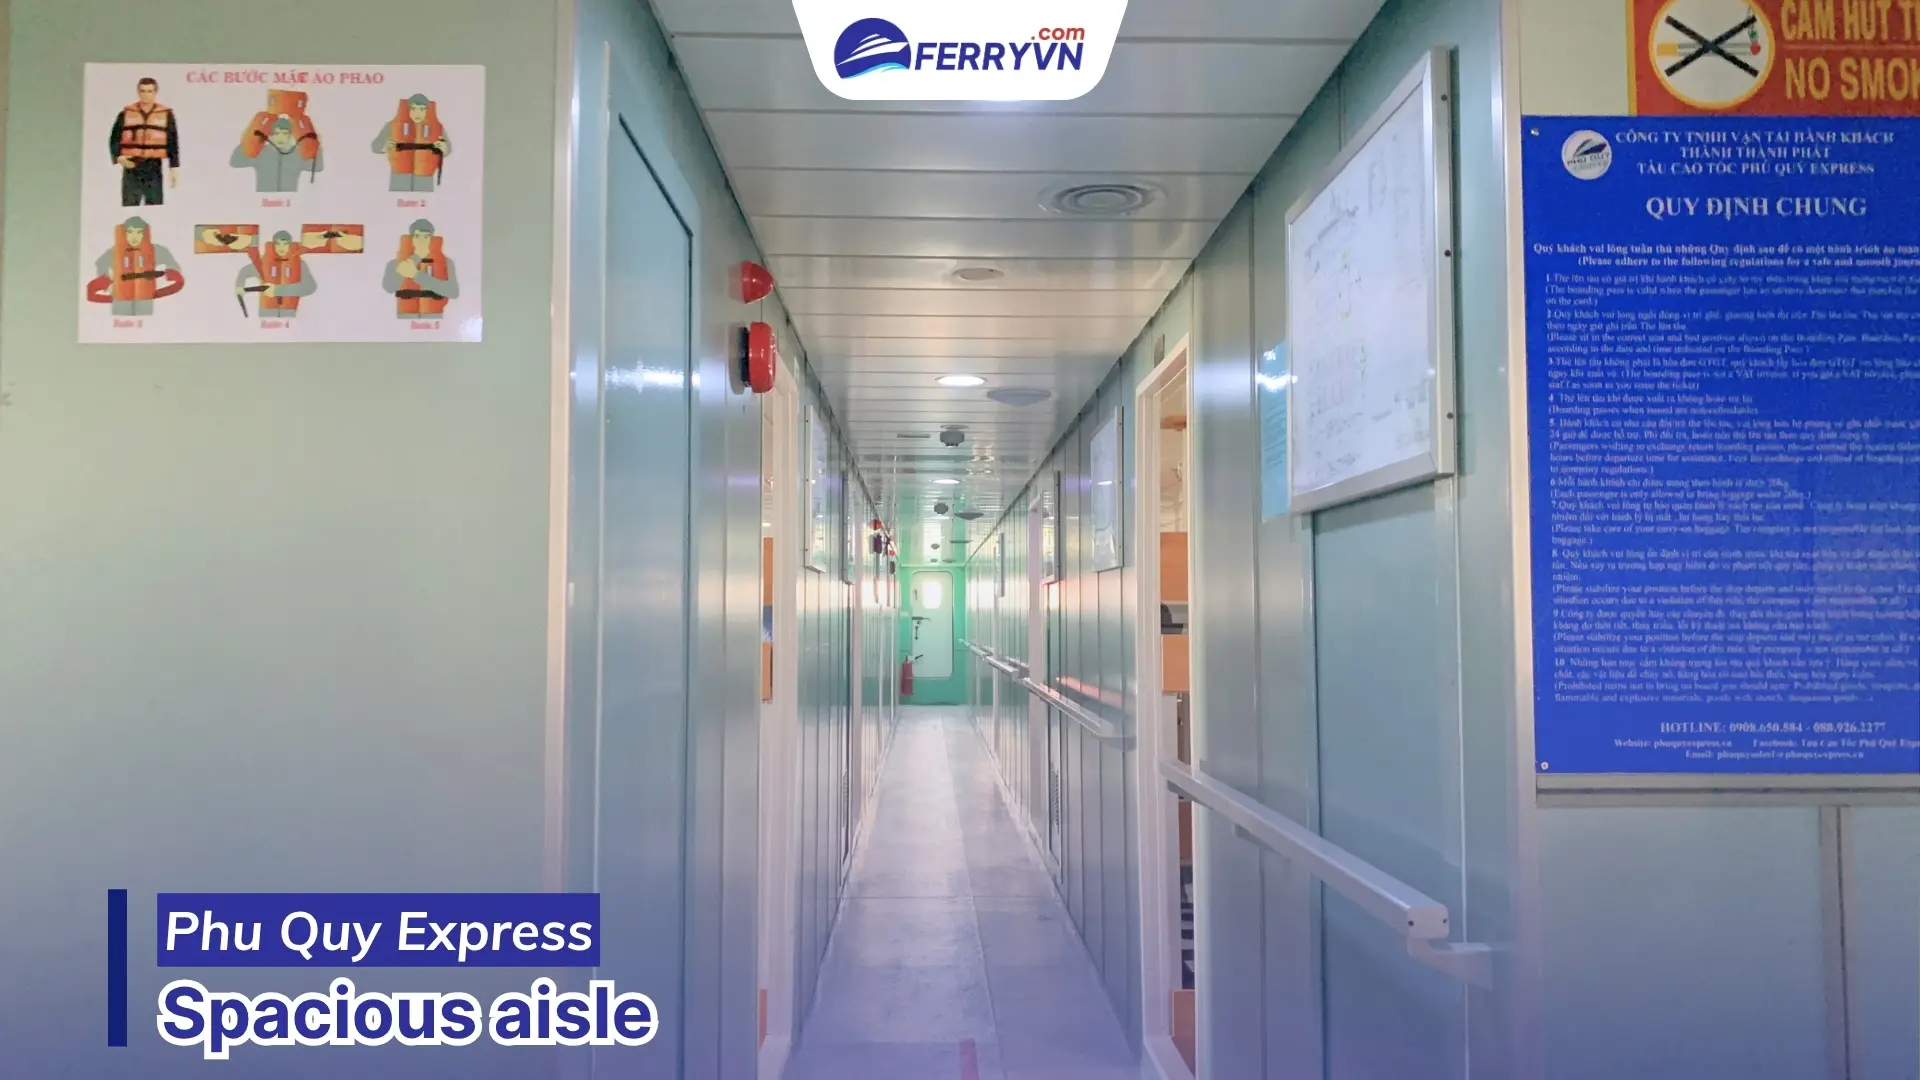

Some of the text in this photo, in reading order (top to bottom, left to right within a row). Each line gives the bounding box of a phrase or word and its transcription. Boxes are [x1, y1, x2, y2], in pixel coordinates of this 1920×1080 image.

[186, 69, 219, 83] CÁC
[223, 69, 268, 83] BƯỚC
[339, 72, 385, 84] PHAO
[1785, 56, 1830, 101] NO
[1664, 132, 1681, 143] TY
[1671, 163, 1702, 174] CAO
[1646, 197, 1867, 221] QUY ĐỊNH CHUNG
[1661, 722, 1726, 731] HOTLINE:
